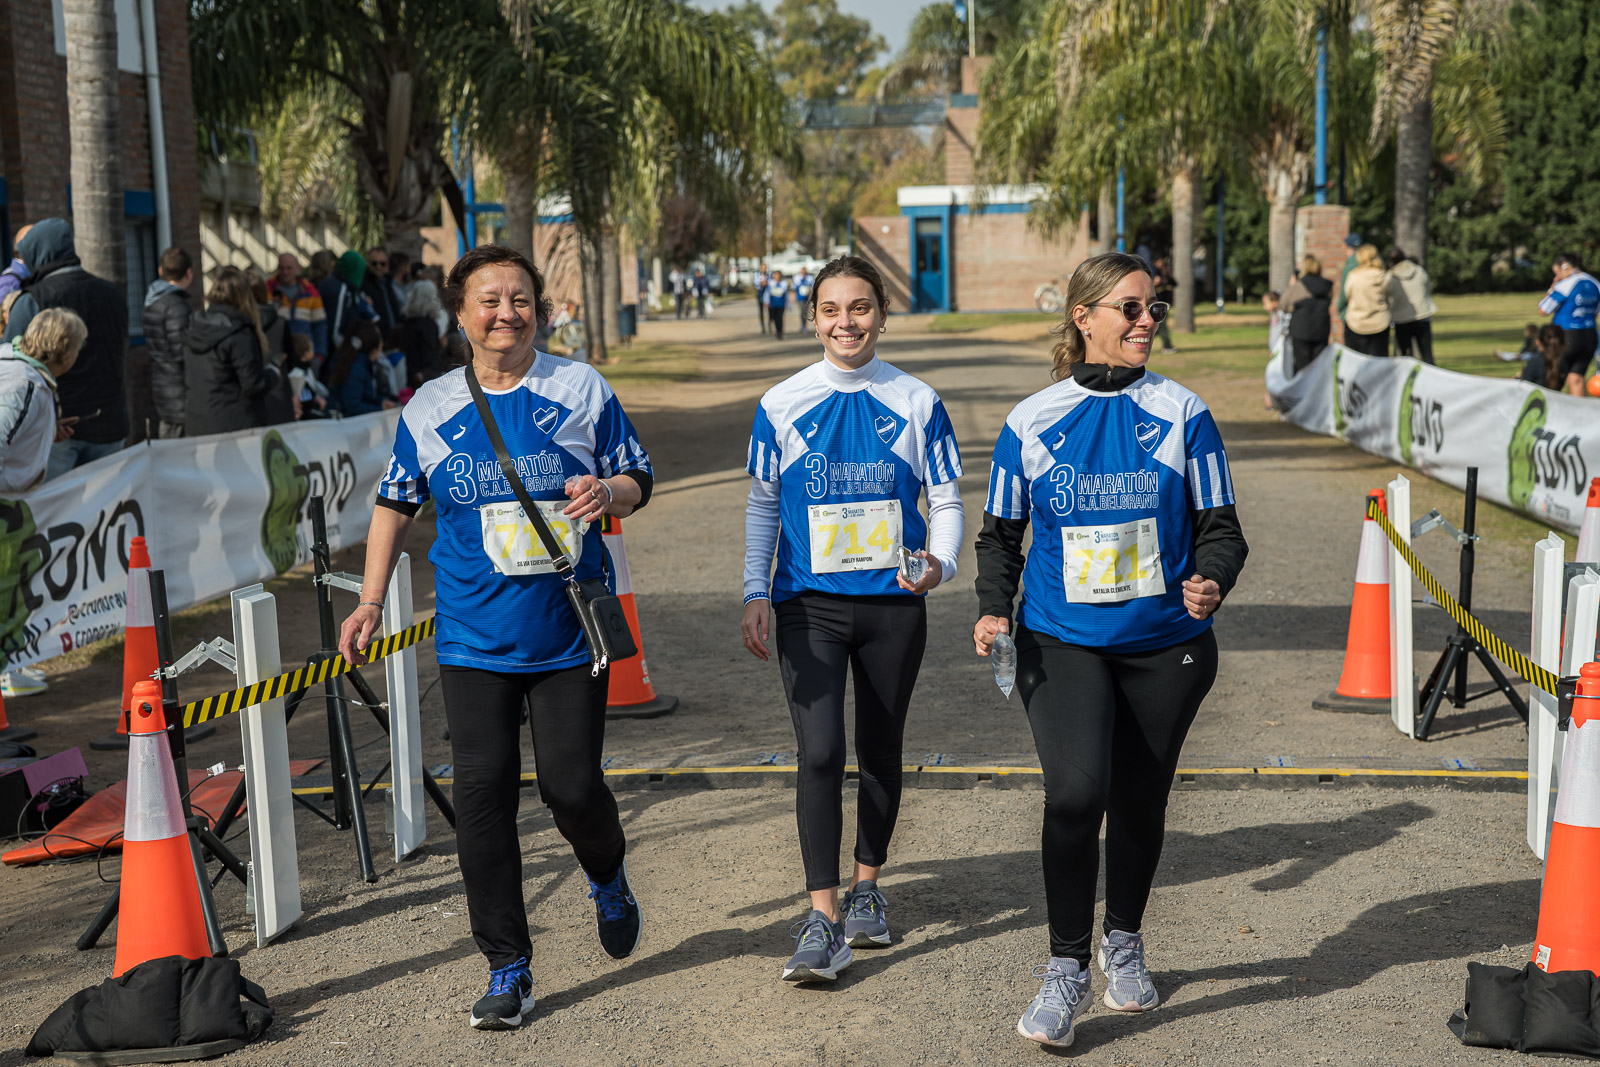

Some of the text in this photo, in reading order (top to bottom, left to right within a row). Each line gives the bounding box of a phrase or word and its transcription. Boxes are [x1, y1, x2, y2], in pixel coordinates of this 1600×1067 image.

[446, 453, 477, 504] 3
[480, 474, 565, 497] C.A.BGRANO
[805, 452, 895, 499] 3 MARATÓN
[1049, 464, 1159, 516] 3 MARATÓN
[518, 506, 525, 518] 3
[842, 507, 848, 519] 3
[818, 520, 894, 557] 714
[1094, 530, 1101, 544] 3
[1074, 543, 1148, 585] 721
